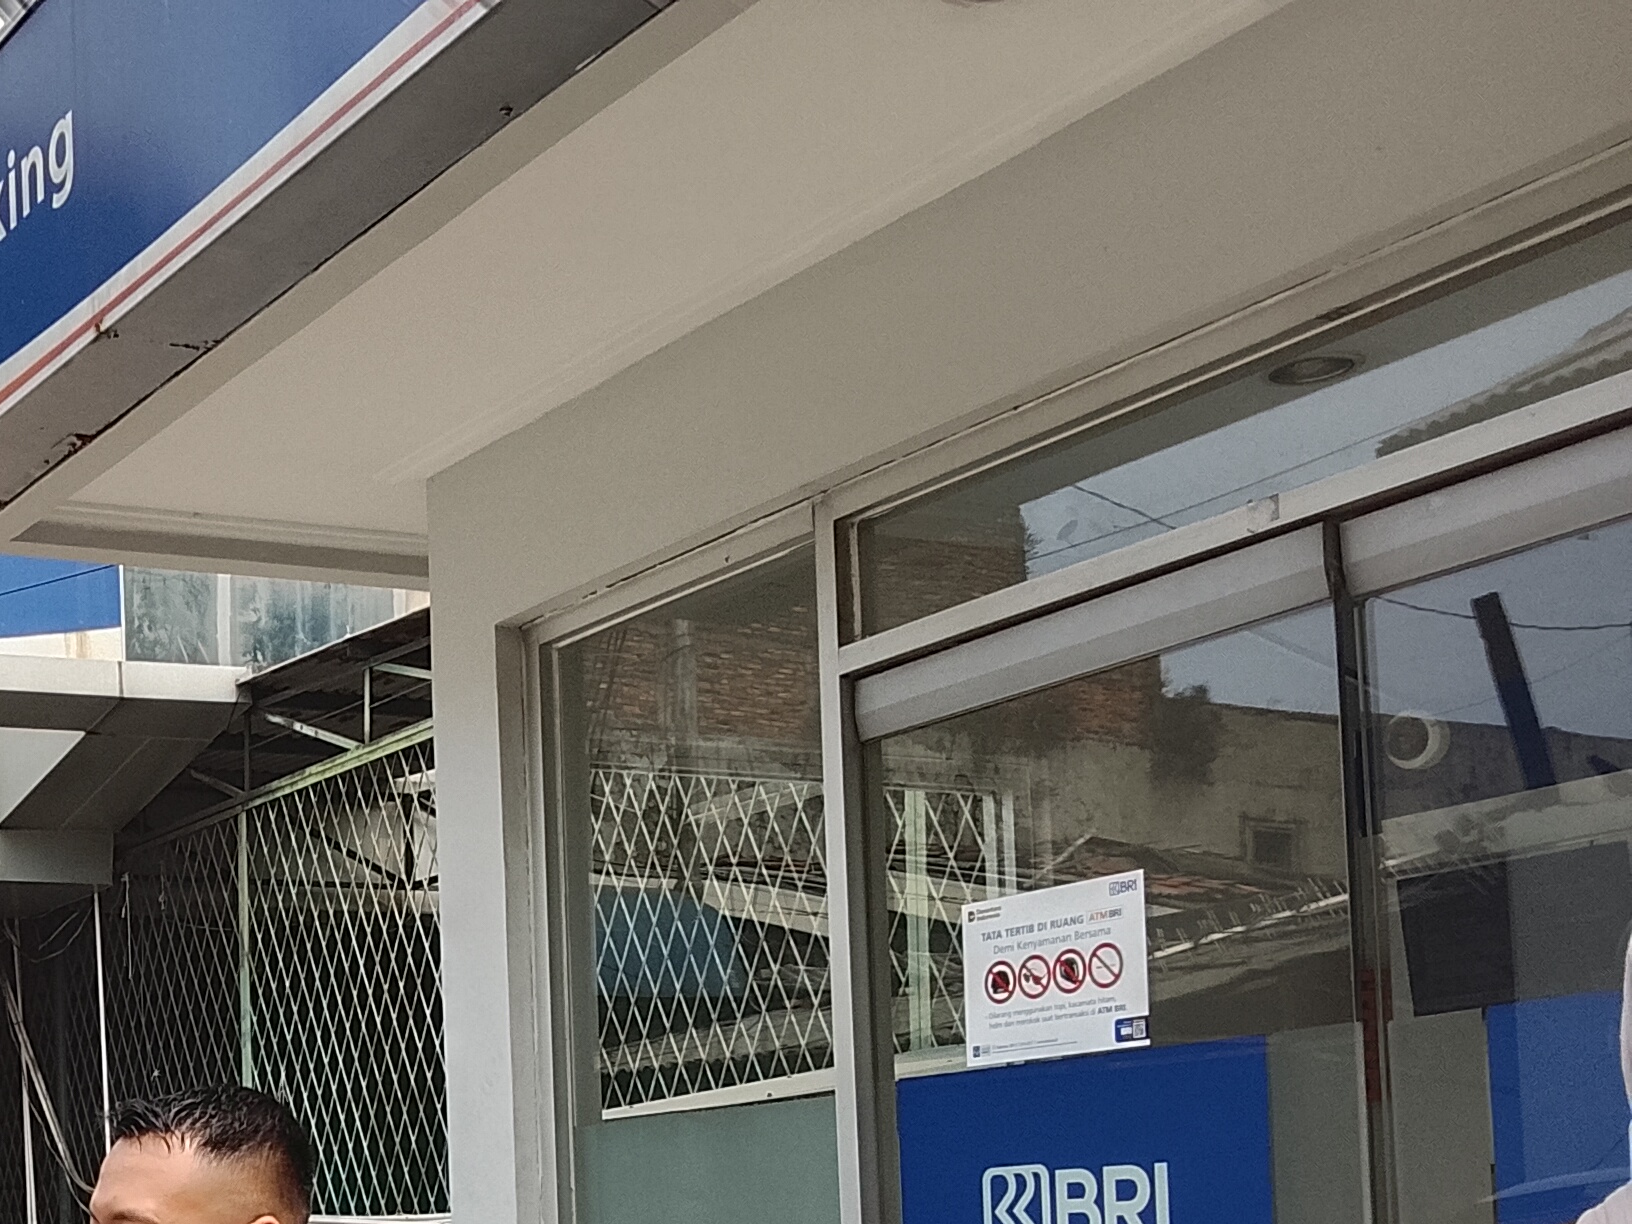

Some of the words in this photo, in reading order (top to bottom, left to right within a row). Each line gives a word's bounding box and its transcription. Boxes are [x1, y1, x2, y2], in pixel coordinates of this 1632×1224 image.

[1119, 879, 1138, 894] BRI
[981, 930, 1002, 942] TATA
[1005, 924, 1035, 937] TERTIB
[1037, 921, 1048, 932] DI
[1050, 914, 1084, 930] RUANG
[993, 944, 1015, 955] Demi
[1017, 934, 1072, 950] Kenyamanan
[1074, 927, 1112, 941] Bersama
